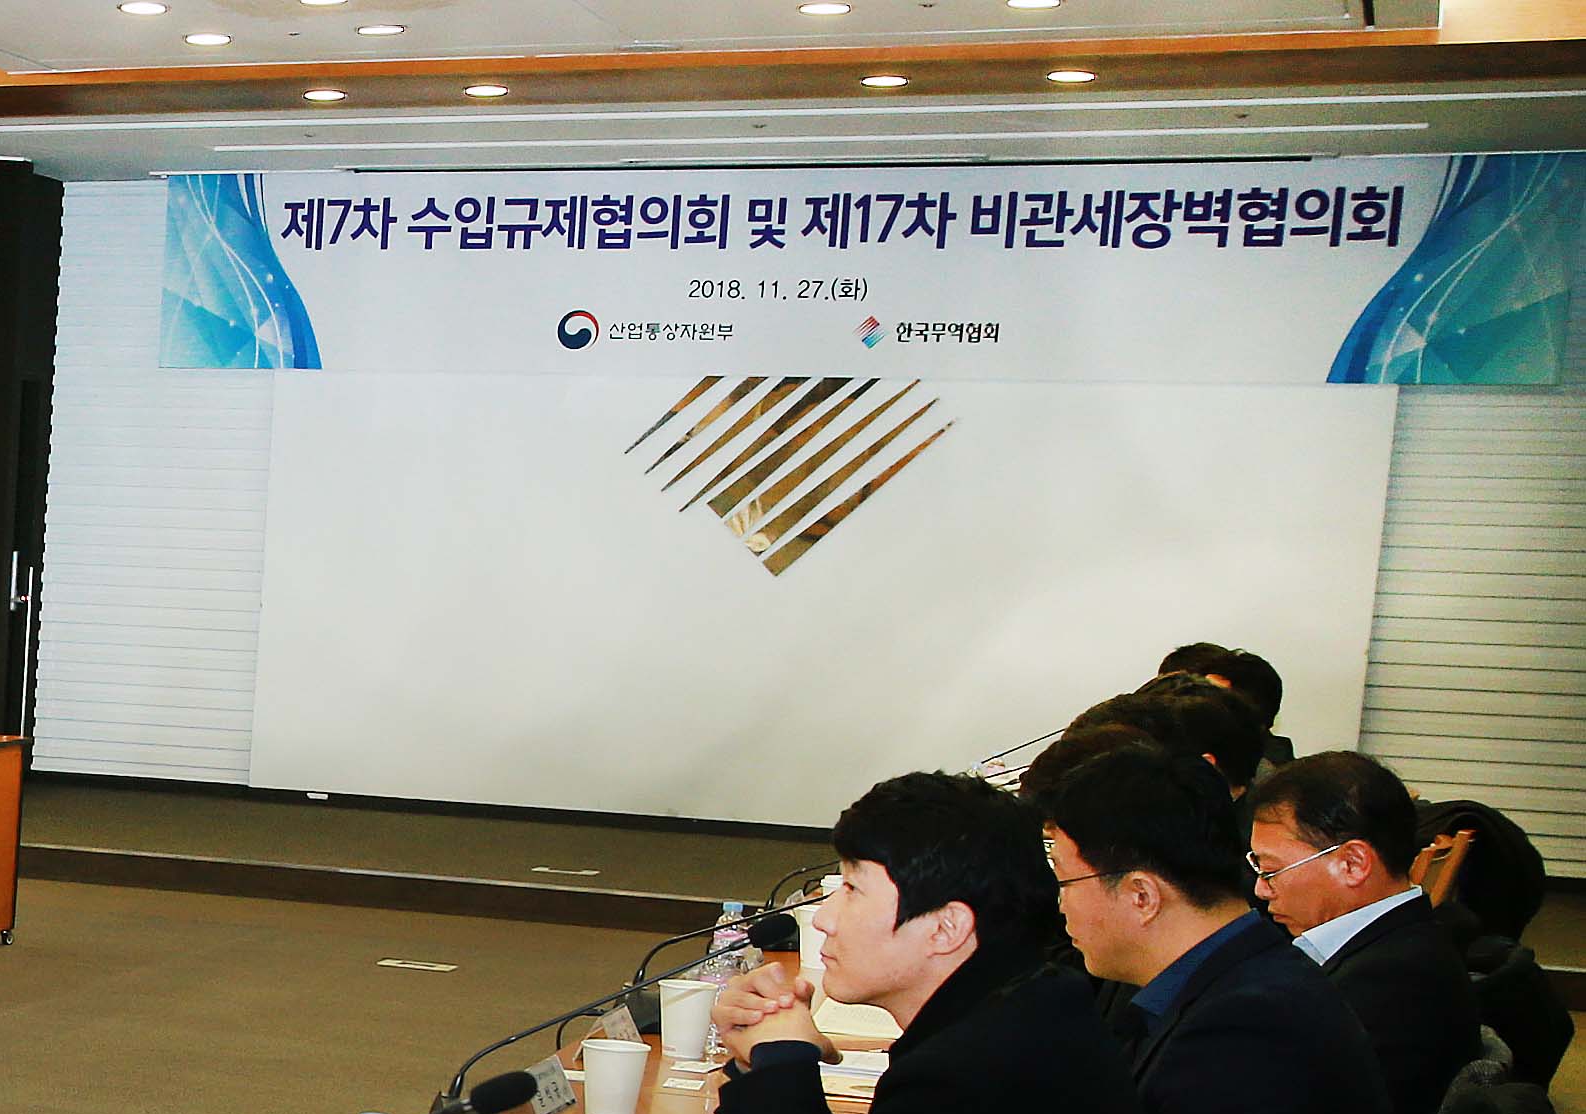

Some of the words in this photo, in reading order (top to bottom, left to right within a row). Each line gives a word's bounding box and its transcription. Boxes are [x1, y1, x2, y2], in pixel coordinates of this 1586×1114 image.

[281, 196, 397, 250] 제7차
[407, 193, 730, 250] 수입규제협의회
[747, 196, 788, 250] 및
[801, 191, 957, 250] 제17차
[971, 185, 1405, 249] 비관세장벽협의회
[689, 279, 746, 300] 2018.
[758, 279, 787, 301] 11.
[797, 277, 868, 303] 27.(화)
[609, 321, 733, 342] 산업통상자원부
[896, 321, 1000, 344] 한국무역협회
